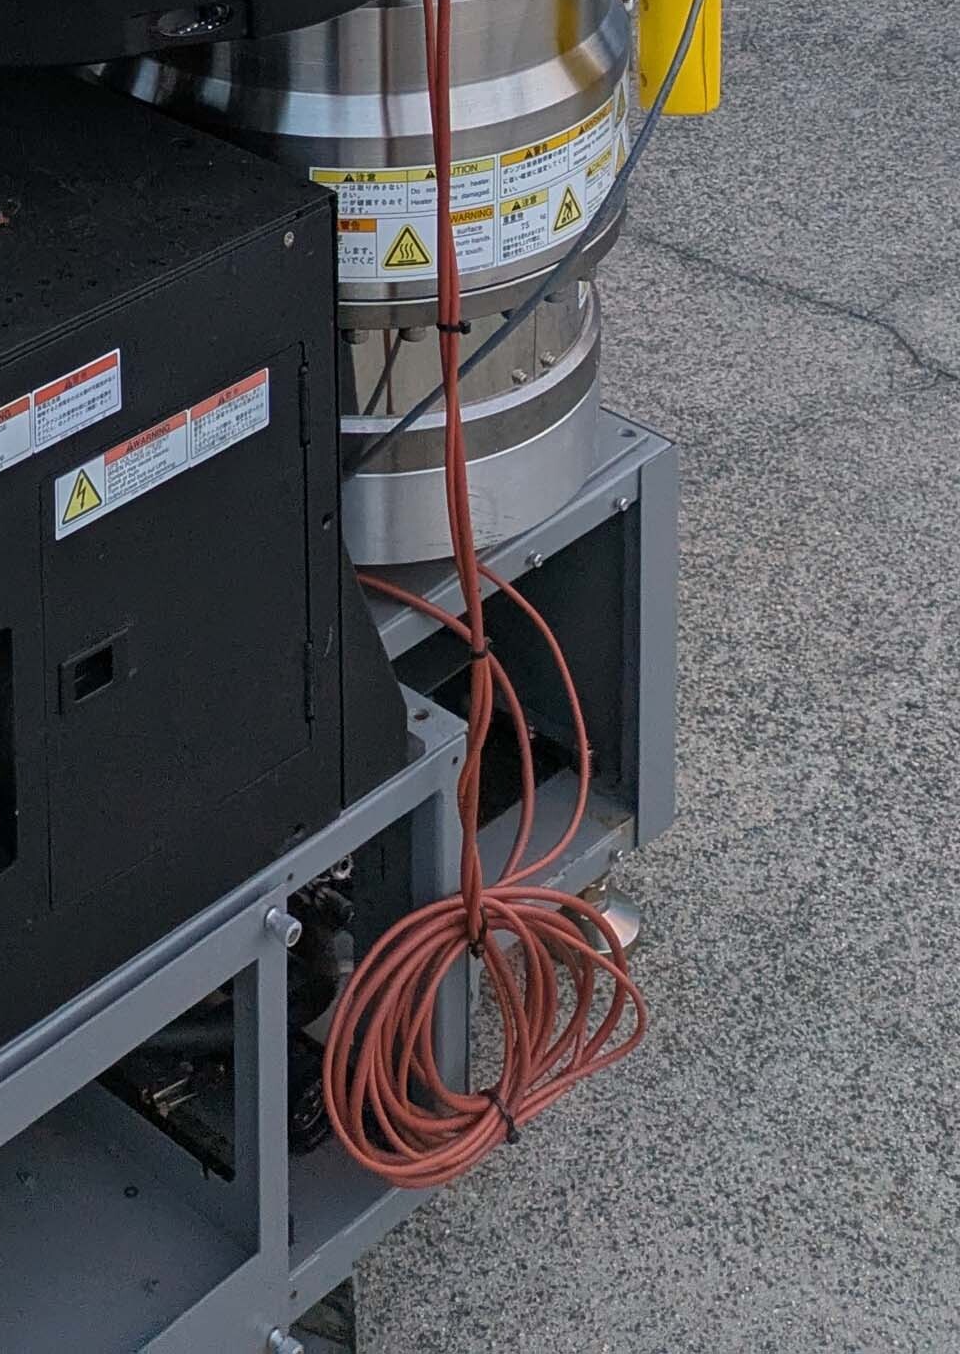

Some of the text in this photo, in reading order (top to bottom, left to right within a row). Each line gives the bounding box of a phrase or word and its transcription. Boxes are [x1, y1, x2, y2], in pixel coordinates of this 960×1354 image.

[451, 164, 478, 176] UTION
[450, 208, 492, 223] WARNING
[133, 423, 170, 449] WARNING
